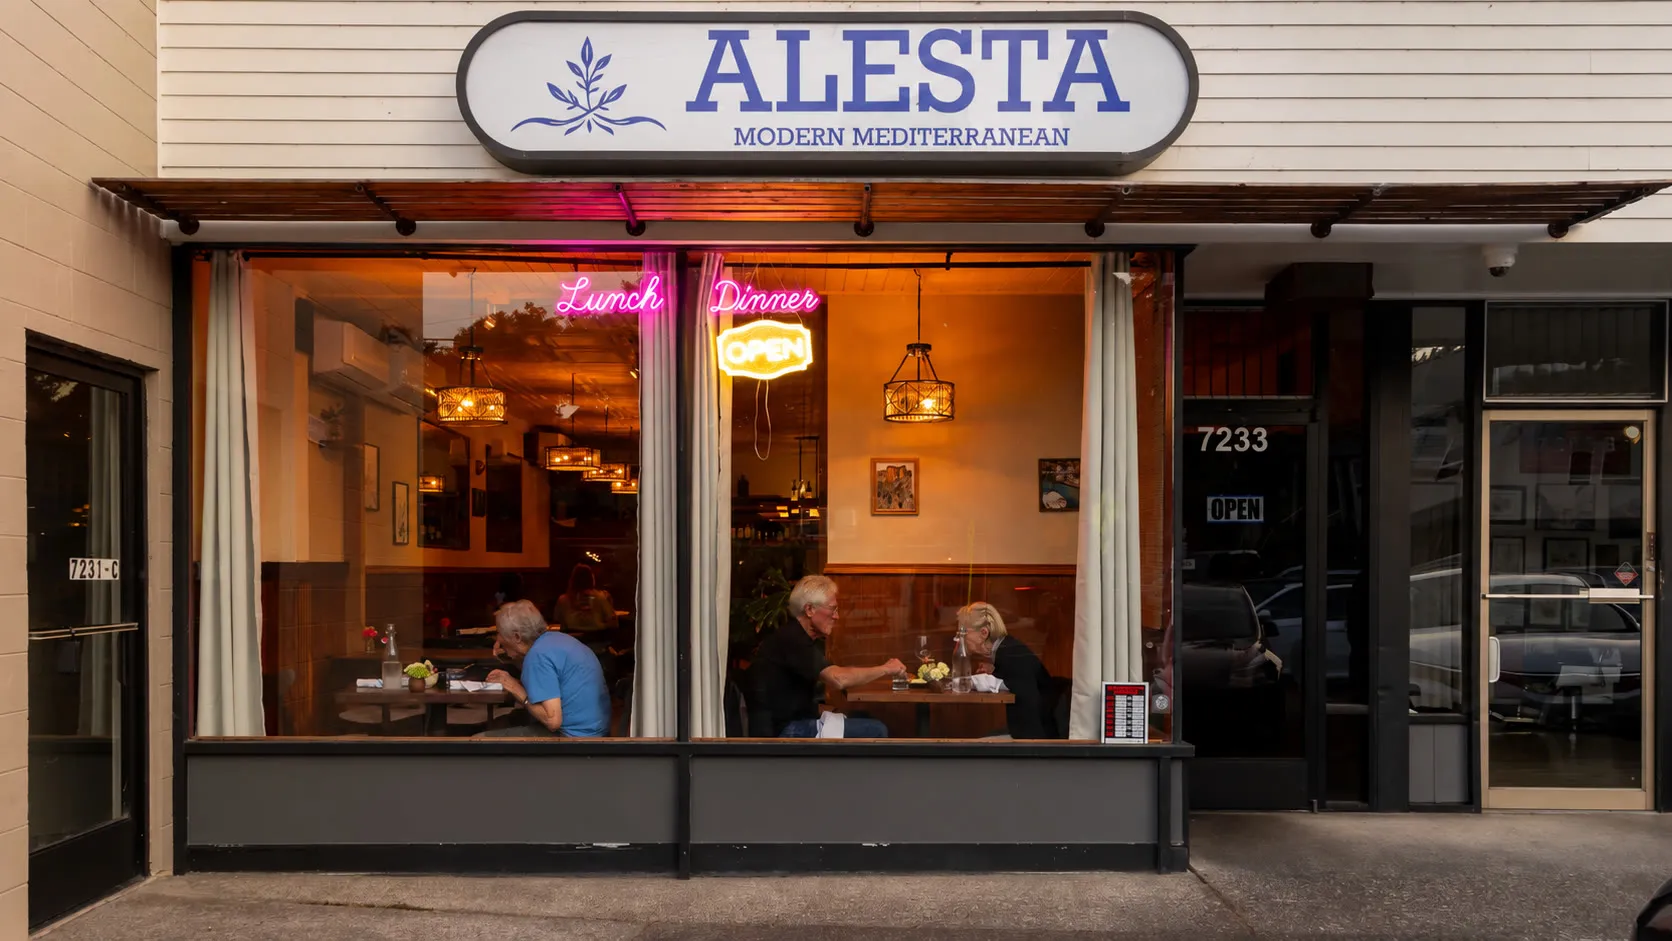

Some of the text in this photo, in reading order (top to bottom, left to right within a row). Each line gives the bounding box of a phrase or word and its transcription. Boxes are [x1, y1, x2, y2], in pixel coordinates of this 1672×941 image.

[686, 28, 1131, 113] ALESTA
[734, 127, 1069, 146] MODERN MEDITERRANEAN
[556, 275, 665, 312] Lunch
[709, 279, 819, 312] Dinner
[725, 337, 803, 365] OPEN
[1197, 426, 1269, 452] 7233
[1210, 498, 1260, 520] OPEN
[71, 559, 118, 579] 7231-C
